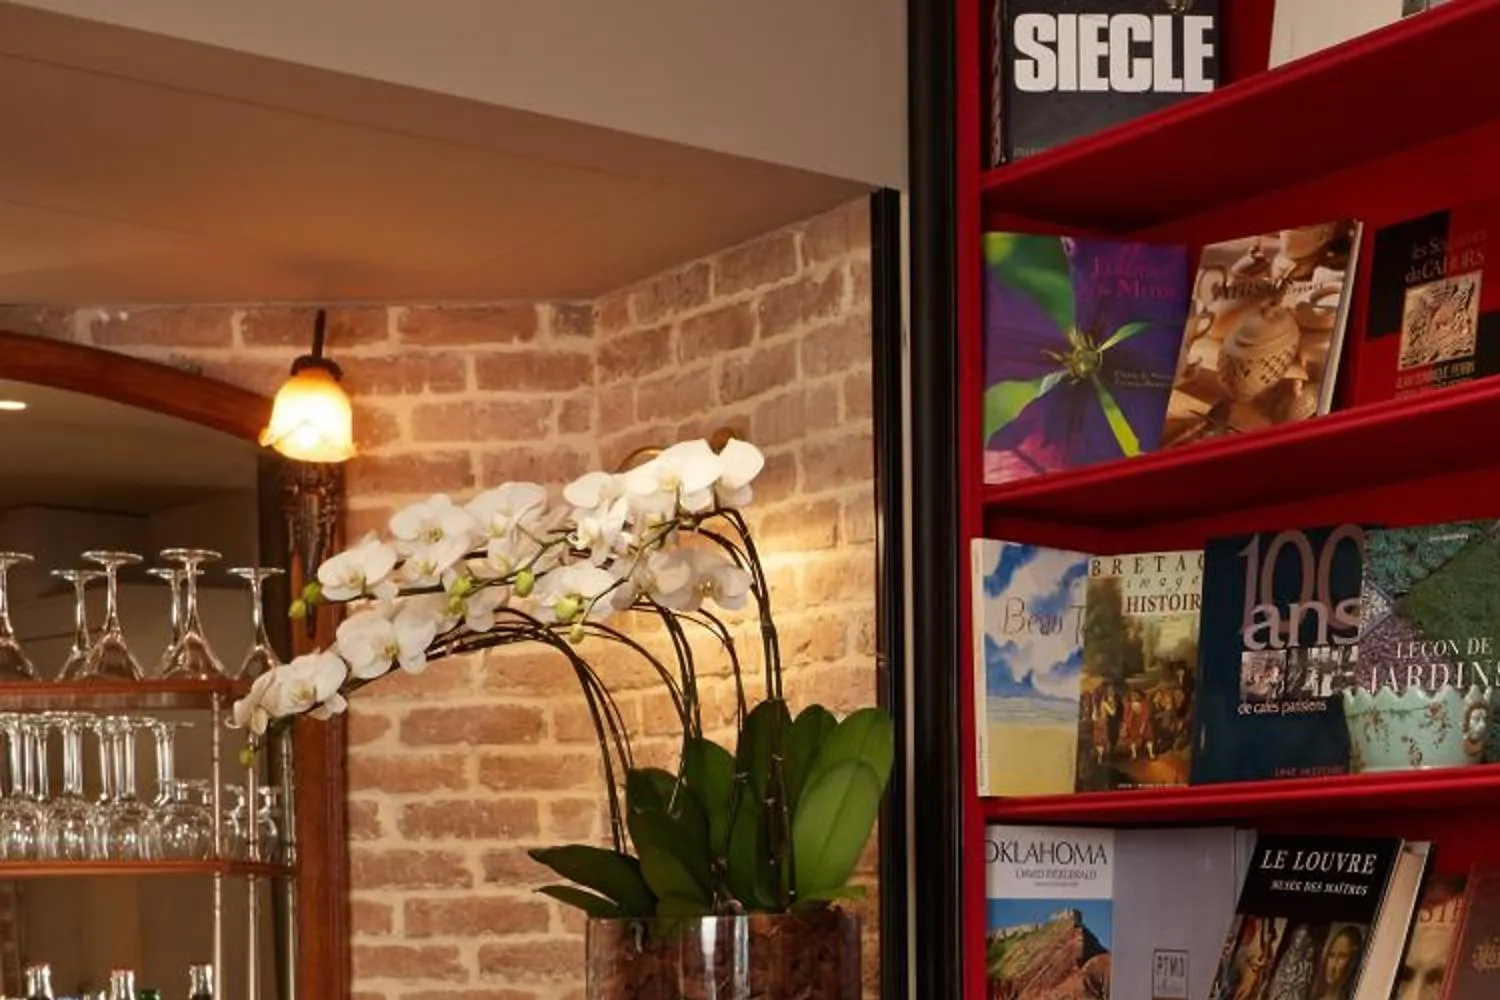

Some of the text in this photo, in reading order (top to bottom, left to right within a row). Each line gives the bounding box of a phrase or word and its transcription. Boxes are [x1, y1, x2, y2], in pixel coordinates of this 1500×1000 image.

[1013, 13, 1215, 92] SIECLE
[1238, 524, 1363, 635] 100
[1126, 593, 1200, 613] HISTOIR
[1242, 597, 1362, 650] ans
[1467, 637, 1494, 656] DE
[984, 840, 1108, 866] OKLAHOMA
[1260, 849, 1378, 875] LE LOUVRE
